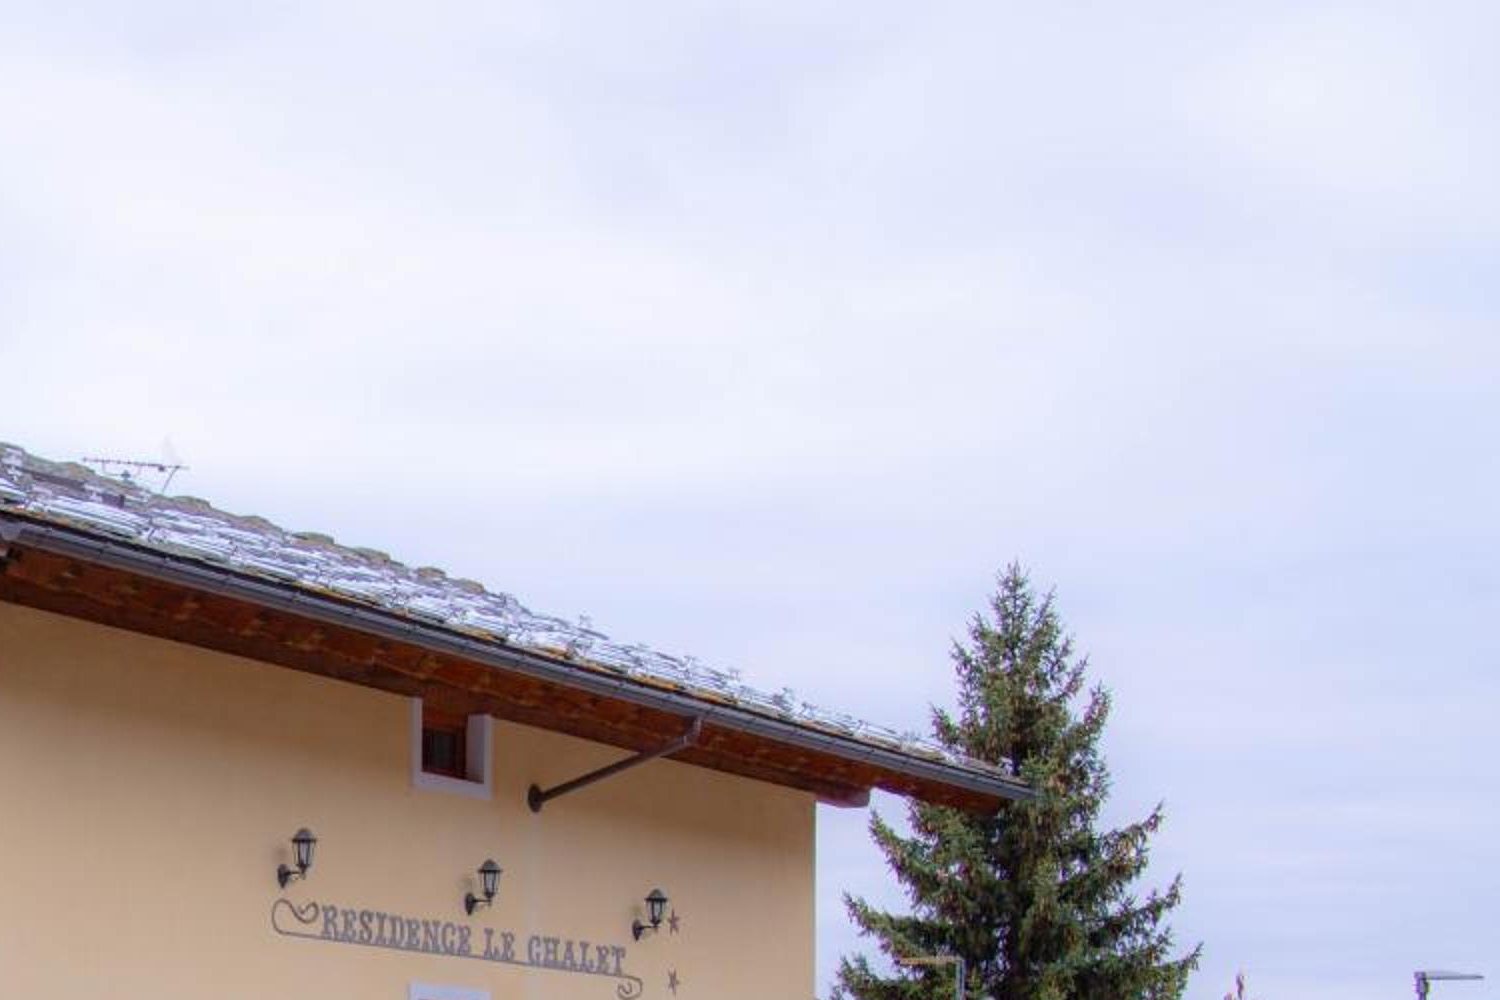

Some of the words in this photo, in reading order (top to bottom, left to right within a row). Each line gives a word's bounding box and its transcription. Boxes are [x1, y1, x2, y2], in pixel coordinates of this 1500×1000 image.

[321, 904, 471, 956] RESIDENCE
[483, 927, 515, 963] LE
[527, 934, 626, 976] CHALET
